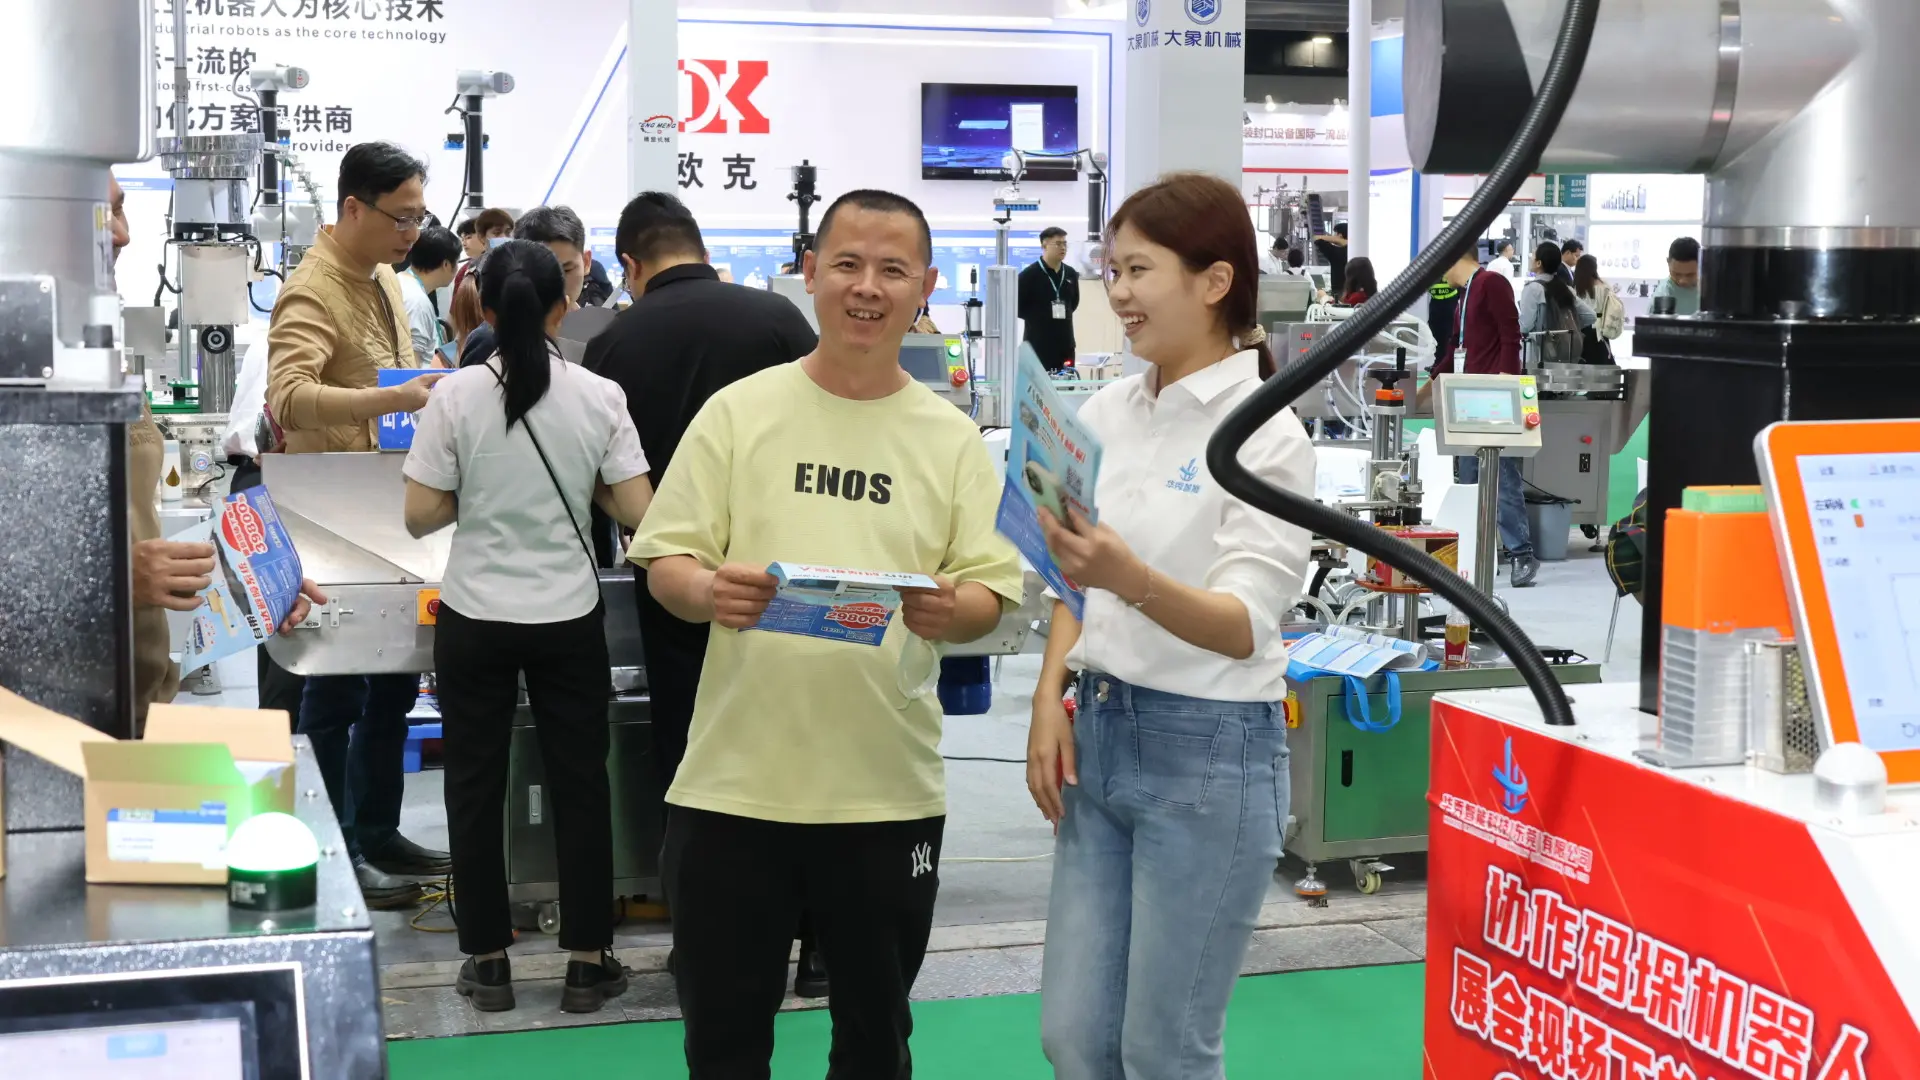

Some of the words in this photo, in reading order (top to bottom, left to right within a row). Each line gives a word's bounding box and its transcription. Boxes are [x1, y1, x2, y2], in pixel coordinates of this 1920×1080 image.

[220, 25, 270, 37] robots
[275, 28, 291, 37] as
[297, 26, 319, 38] the
[324, 29, 357, 39] core
[362, 30, 446, 44] technology
[1164, 29, 1242, 48] 大象机械
[288, 139, 351, 153] rovider
[678, 151, 757, 190] 欧克
[794, 462, 893, 505] ENOS
[1450, 946, 1697, 1080] 展会现场下
